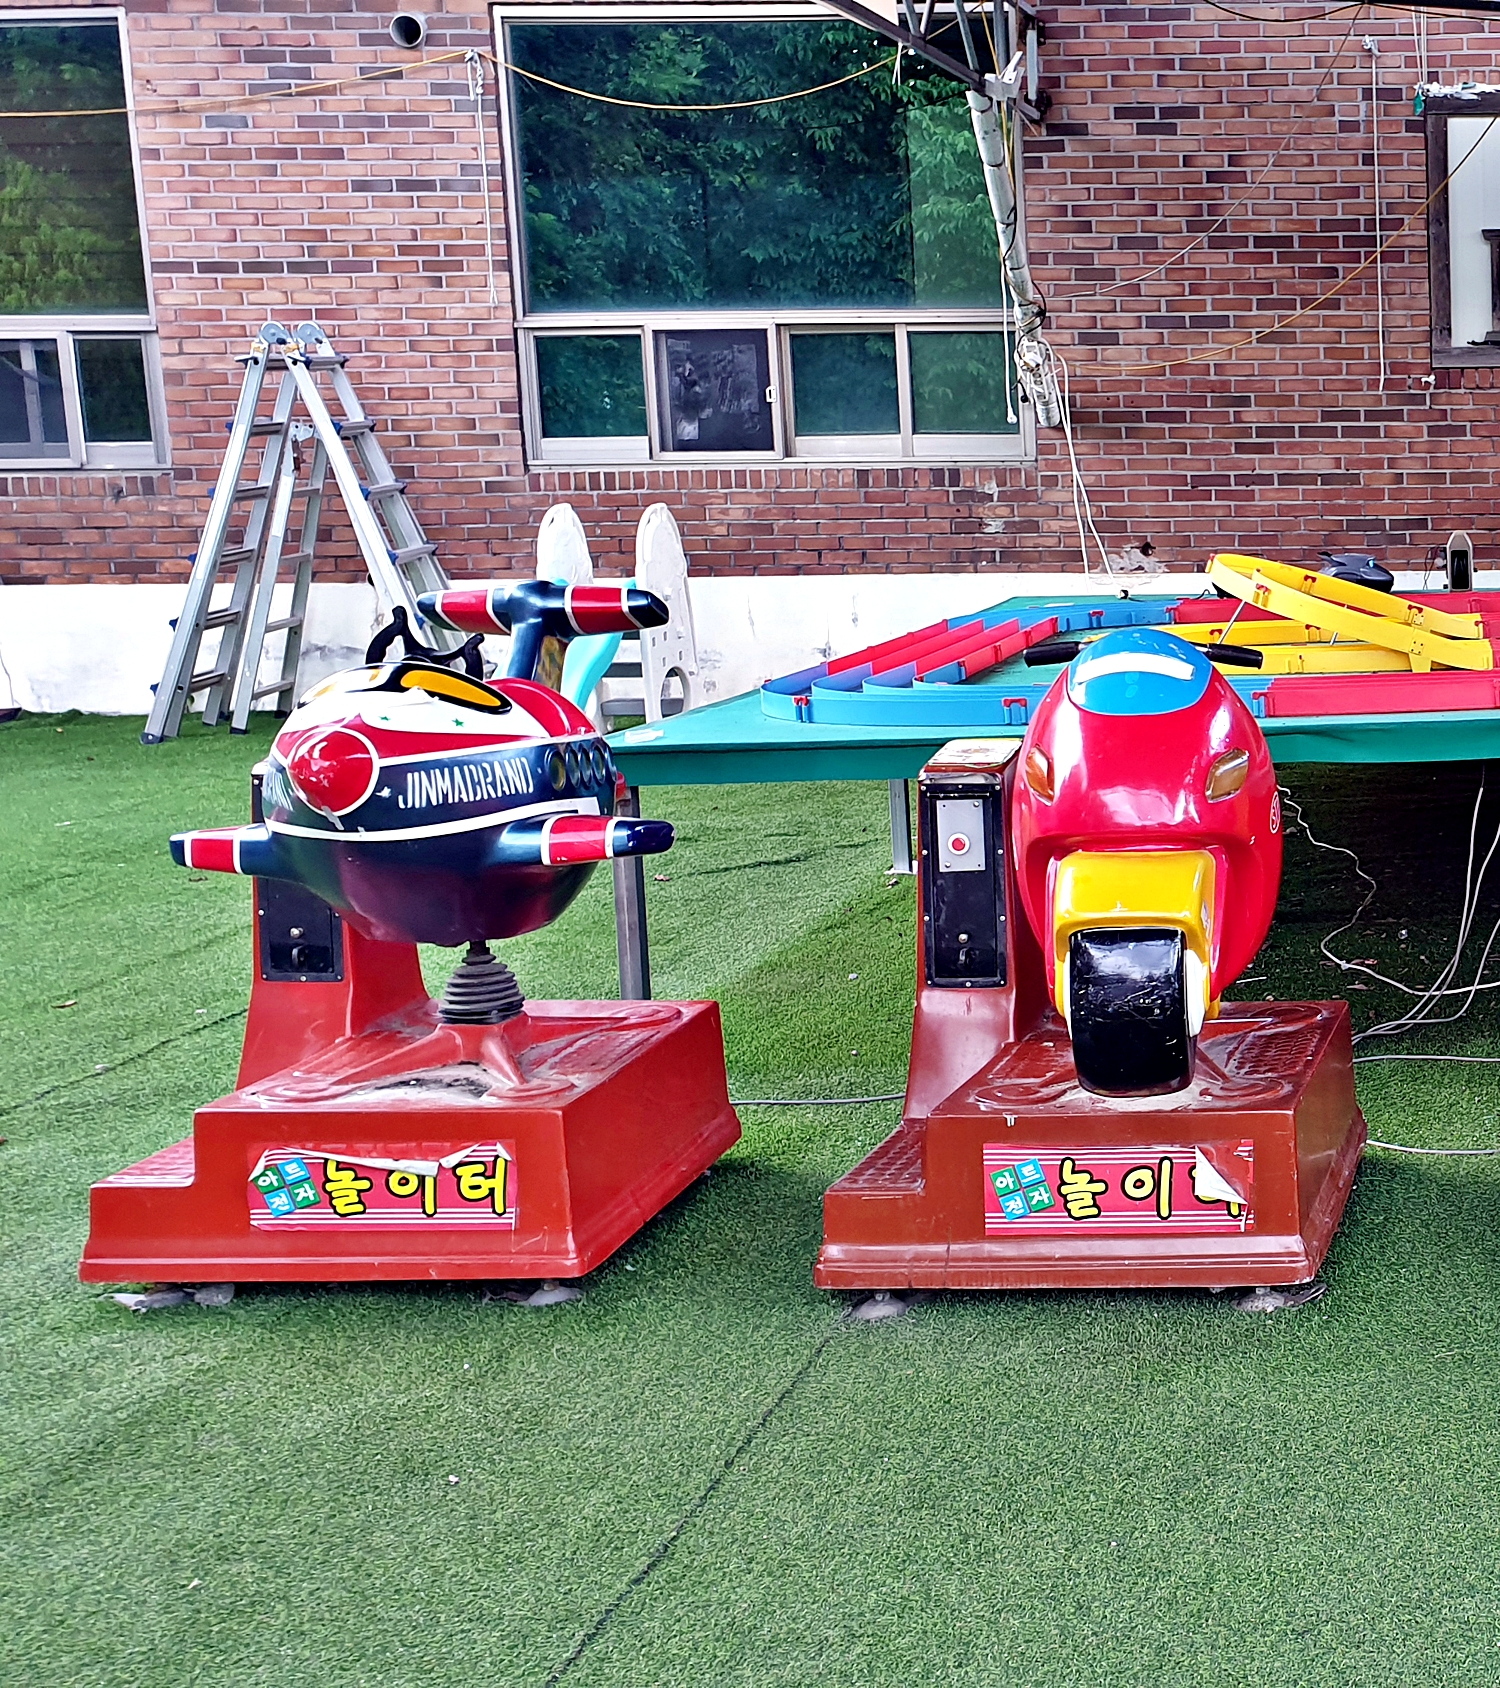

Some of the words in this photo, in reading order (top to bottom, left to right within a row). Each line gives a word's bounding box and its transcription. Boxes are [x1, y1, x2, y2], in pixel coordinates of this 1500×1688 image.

[398, 757, 534, 809] JINMABRAND
[257, 1161, 305, 1187] 아트
[323, 1156, 508, 1217] 놀이터
[995, 1163, 1044, 1190] 아트
[1058, 1156, 1242, 1220] 놀이
[269, 1183, 316, 1211] 전자
[1004, 1186, 1050, 1215] 전자
